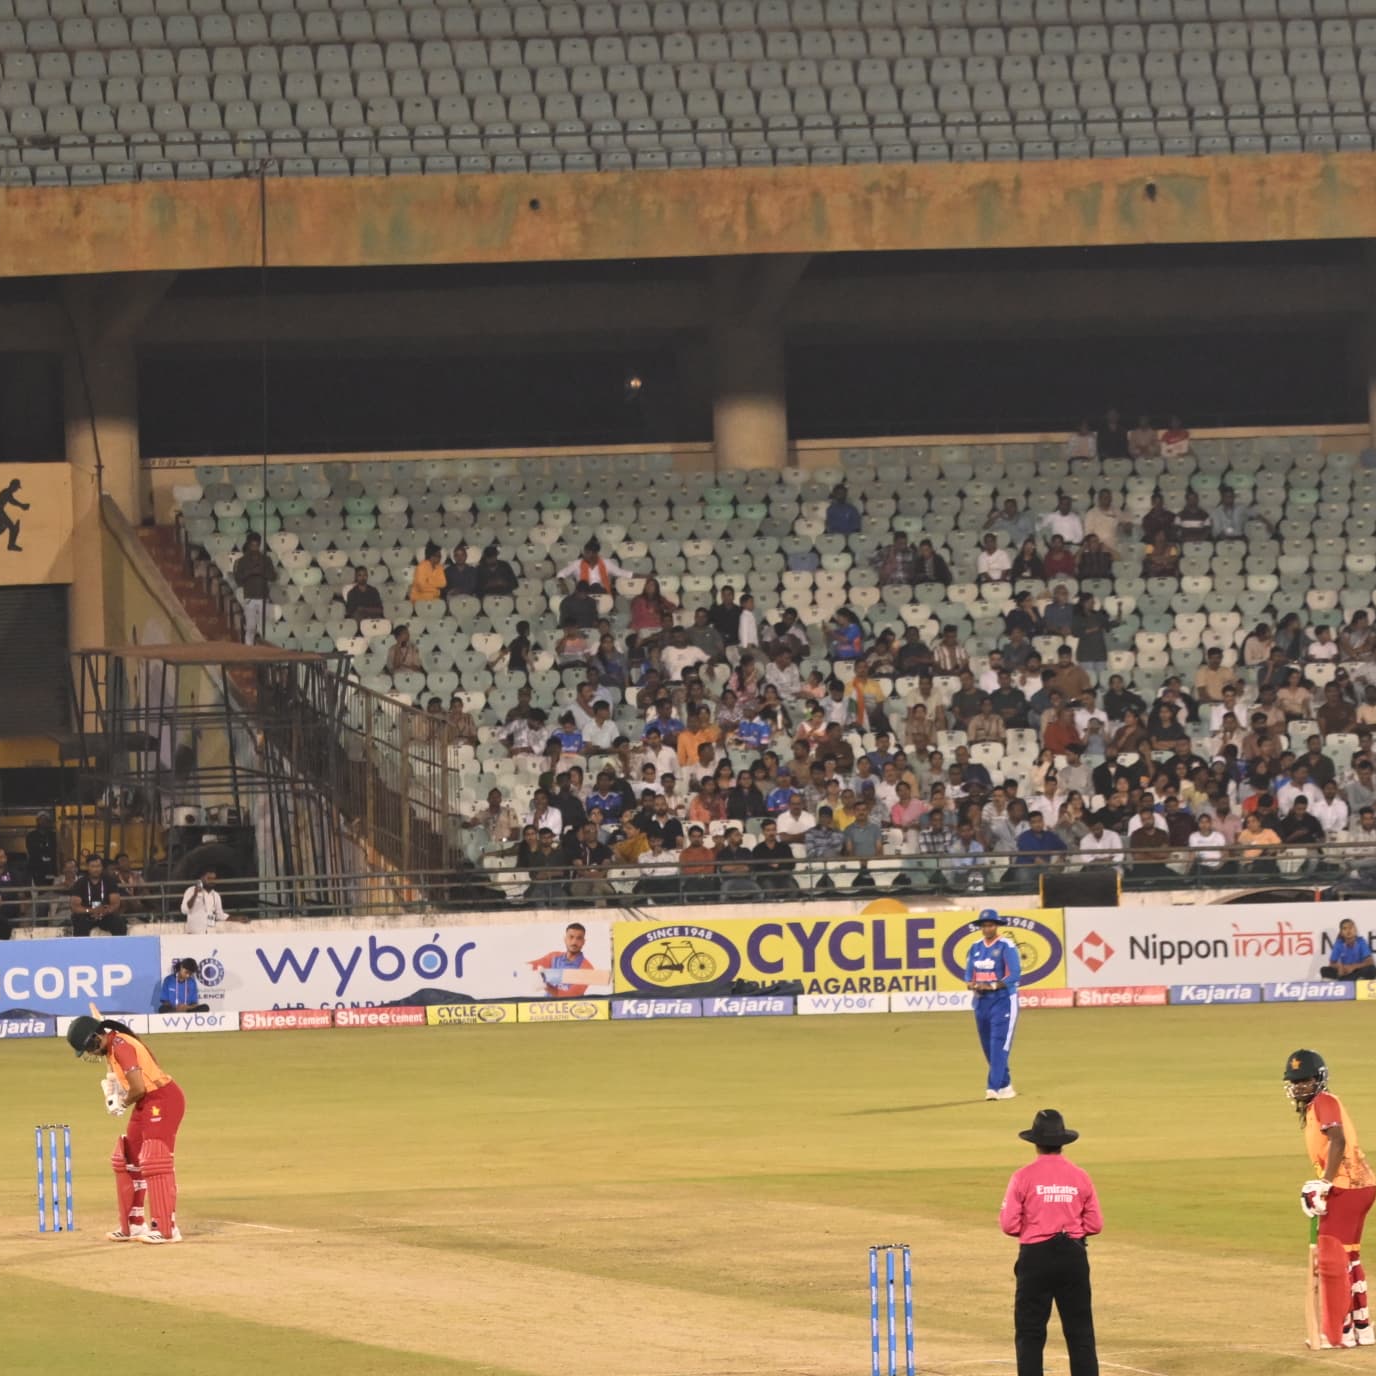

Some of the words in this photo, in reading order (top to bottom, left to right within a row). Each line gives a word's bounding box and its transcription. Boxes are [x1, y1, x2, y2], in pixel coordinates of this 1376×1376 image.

[646, 927, 680, 942] SINCE
[684, 926, 713, 940] 1948
[746, 917, 937, 974] CYCLE
[1129, 934, 1229, 967] Nippon
[1232, 922, 1315, 958] india
[807, 975, 937, 996] AGARBATHI
[1274, 981, 1346, 1001] Kajaria
[1079, 991, 1133, 1005] Shree
[1180, 985, 1253, 1004] Kajaria
[437, 1007, 476, 1018] CYCLE
[529, 1003, 569, 1015] CYCLE
[622, 1000, 693, 1017] Kajaria
[712, 996, 784, 1015] Kajaria
[243, 1013, 296, 1028] Shree
[335, 1011, 389, 1025] Shree
[1036, 1184, 1078, 1195] Emirates
